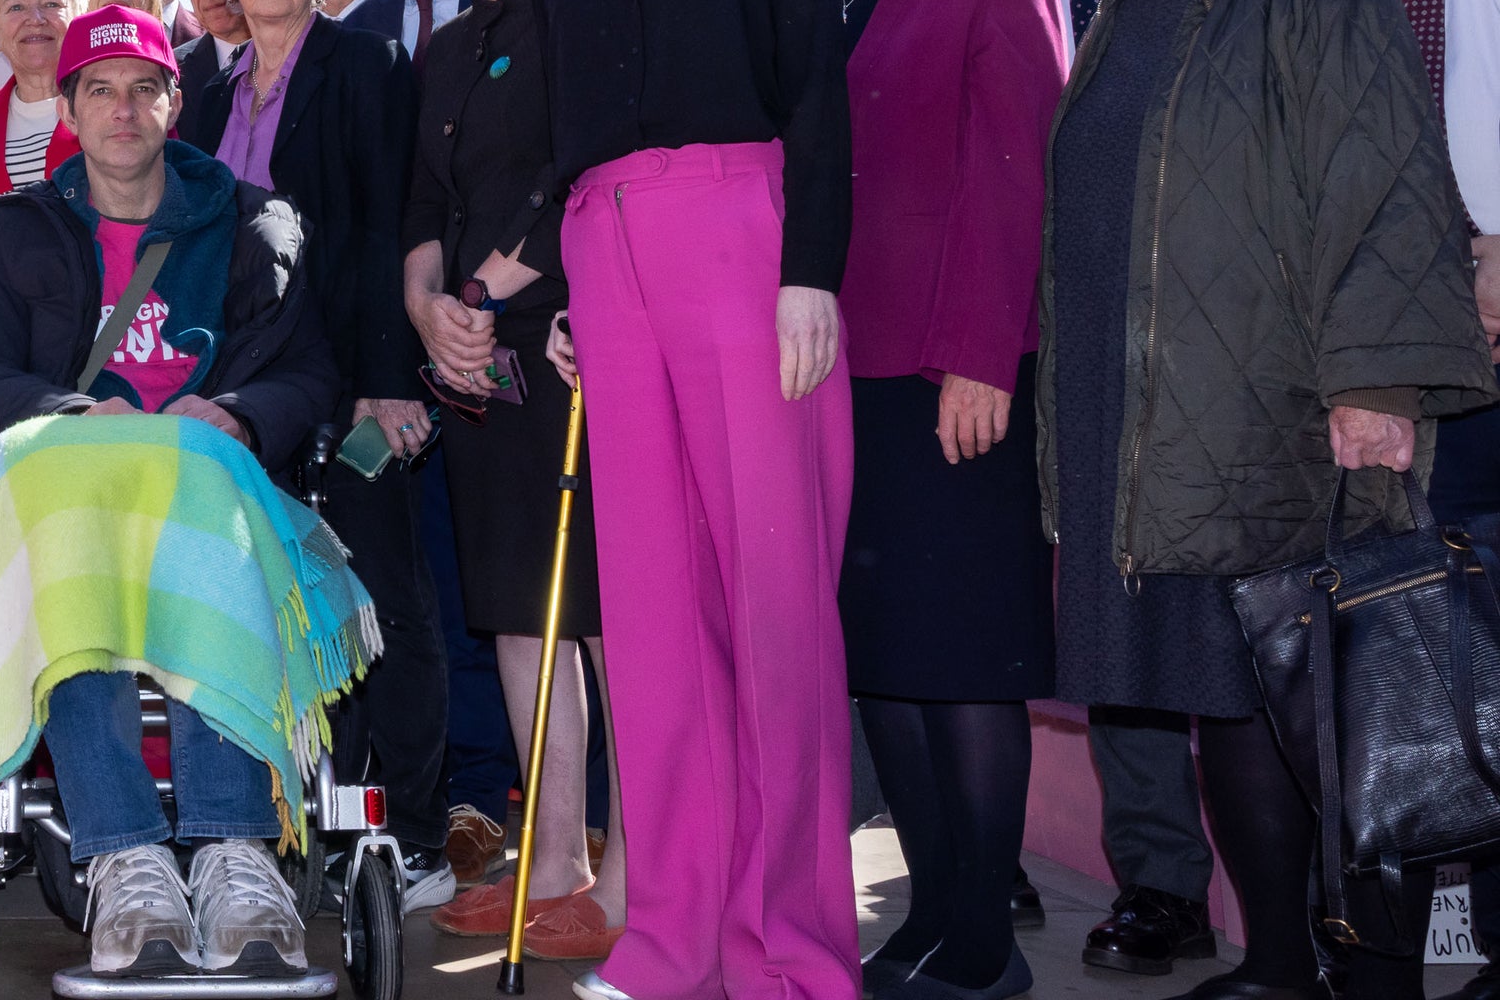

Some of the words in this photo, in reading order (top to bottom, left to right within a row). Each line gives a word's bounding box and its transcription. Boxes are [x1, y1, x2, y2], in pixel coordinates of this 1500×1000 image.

[89, 23, 123, 33] CAMPAIGN
[90, 28, 137, 40] DIGNITY
[90, 39, 103, 49] IN
